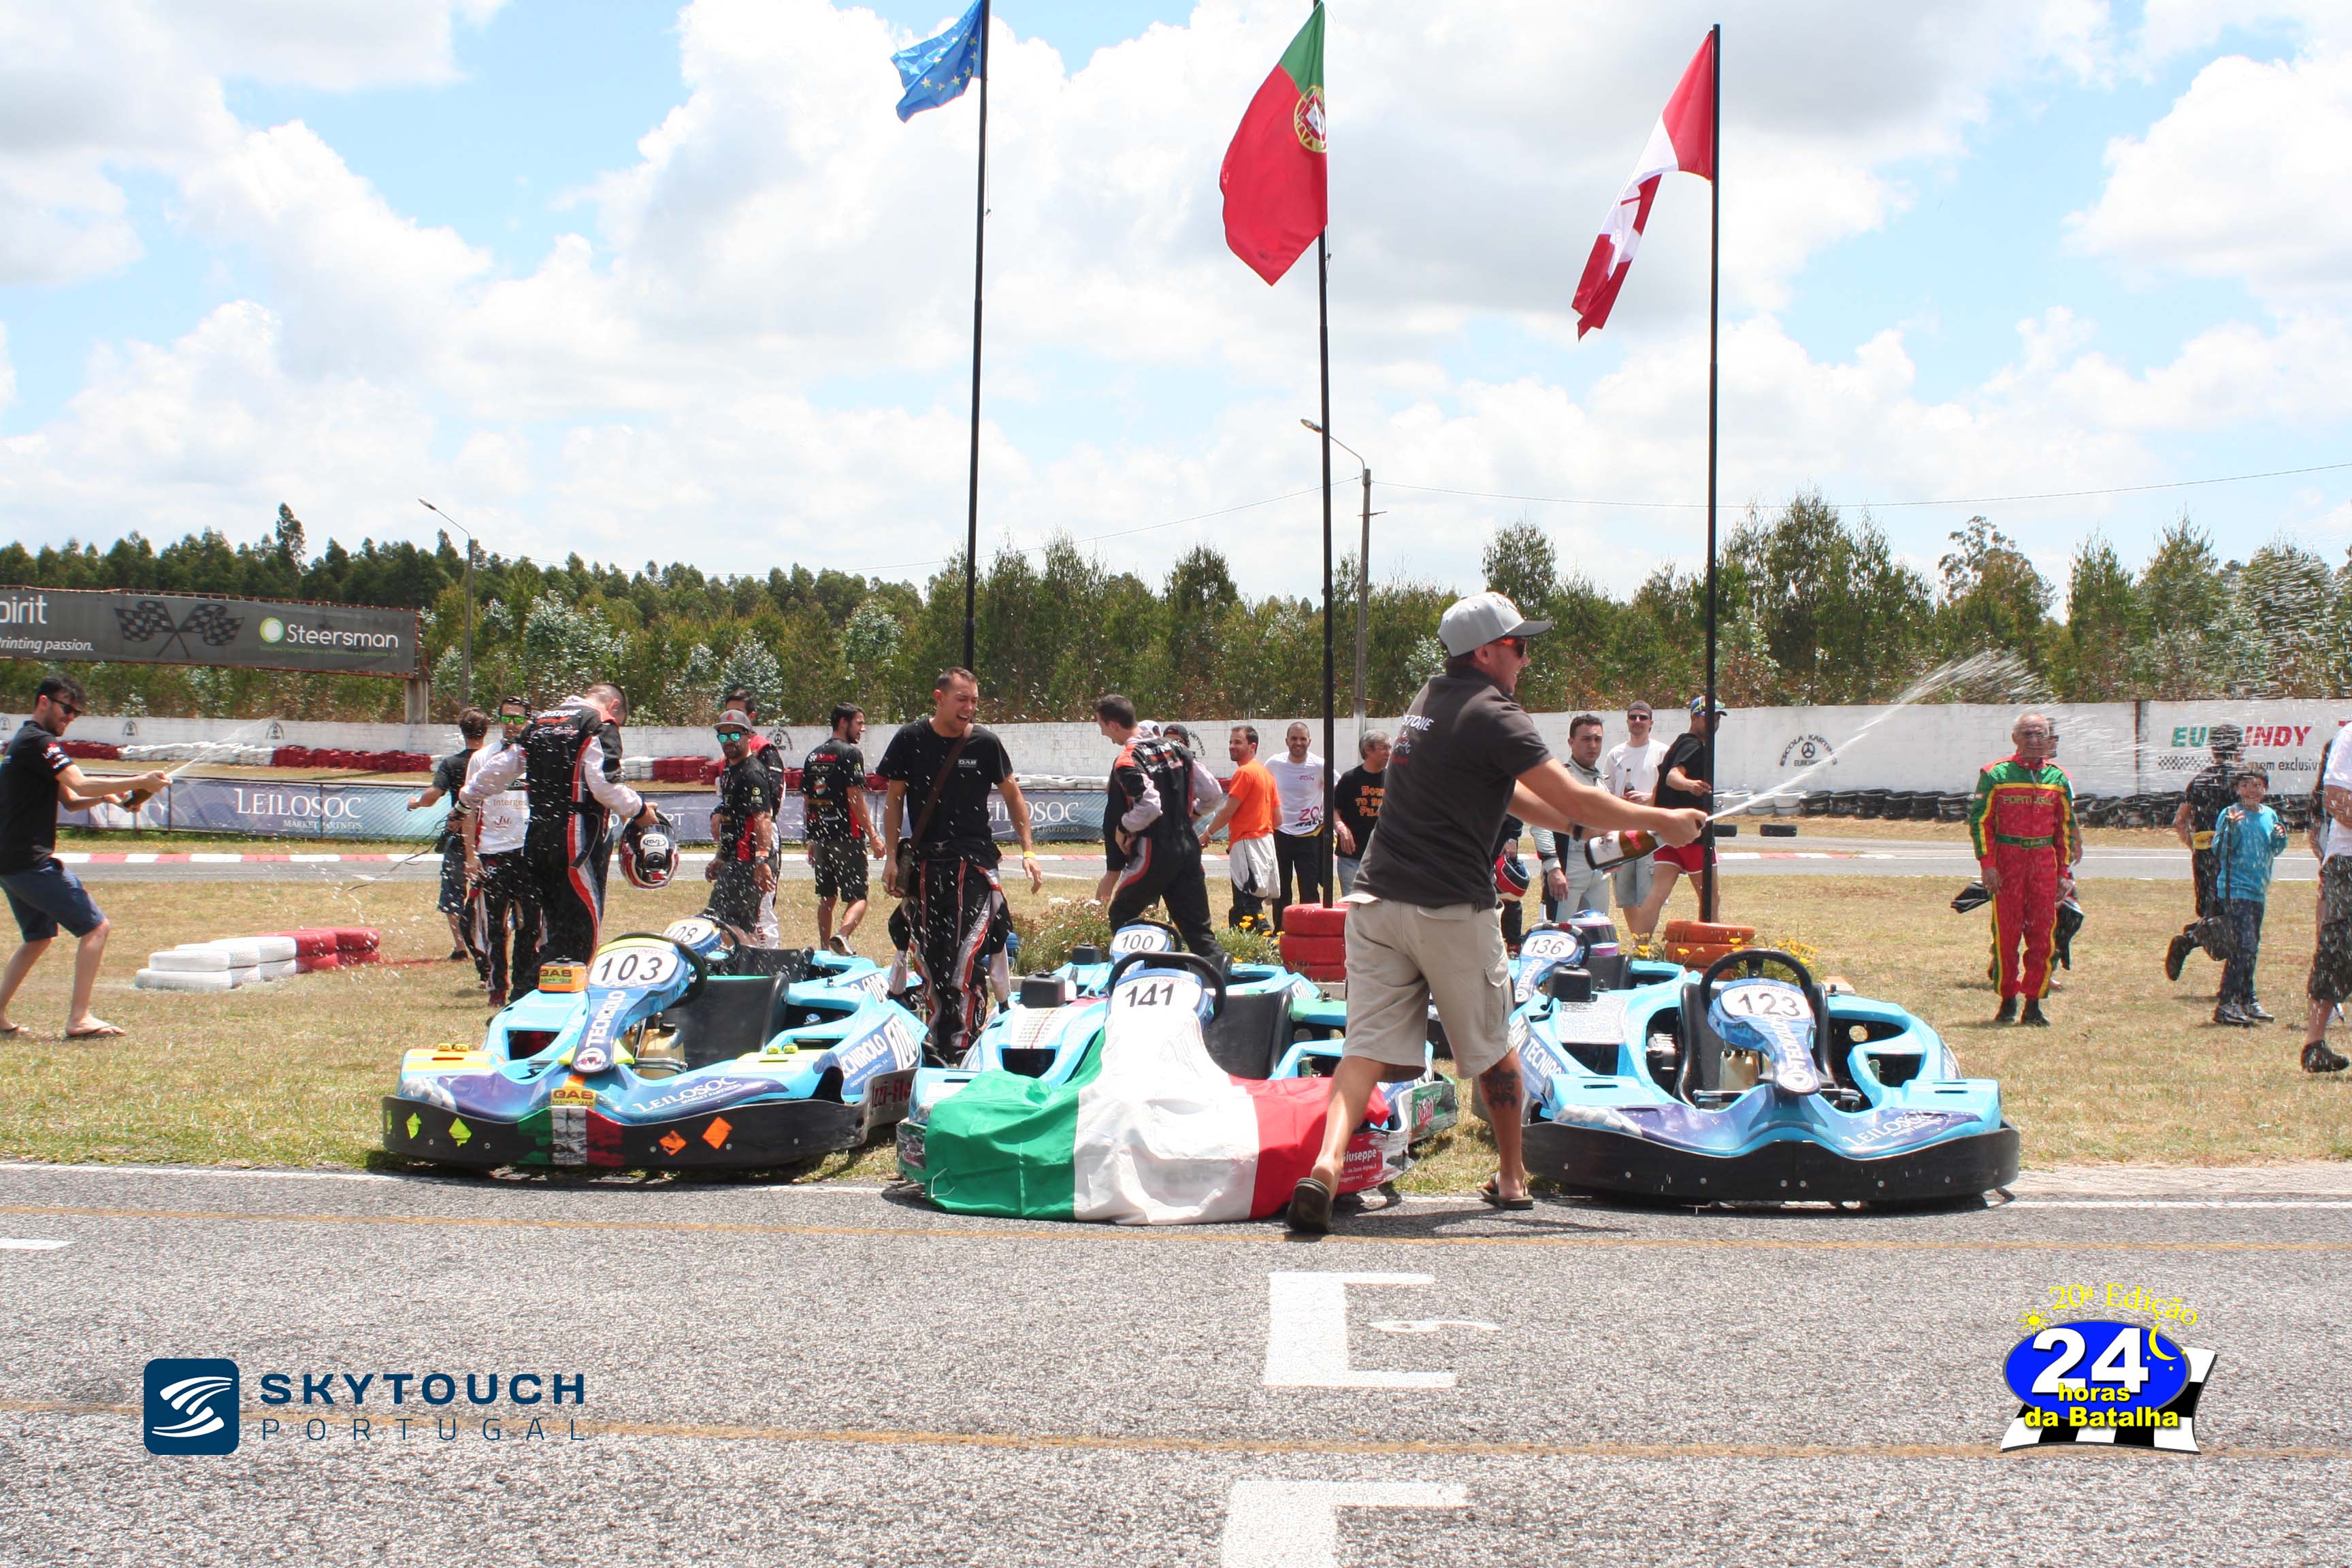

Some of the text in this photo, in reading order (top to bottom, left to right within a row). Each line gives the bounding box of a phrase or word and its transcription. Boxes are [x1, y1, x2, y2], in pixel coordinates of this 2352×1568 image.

[0, 636, 95, 653] rinting passion.
[287, 623, 399, 648] Steersman
[233, 788, 362, 818] LEILOSOC
[283, 819, 318, 828] MARKET
[1122, 934, 1154, 950] 100
[1531, 939, 1564, 955] 136
[600, 953, 663, 982] 103
[1125, 983, 1174, 1007] 141
[1738, 993, 1801, 1017] 123
[632, 1077, 738, 1113] LEILOSOC
